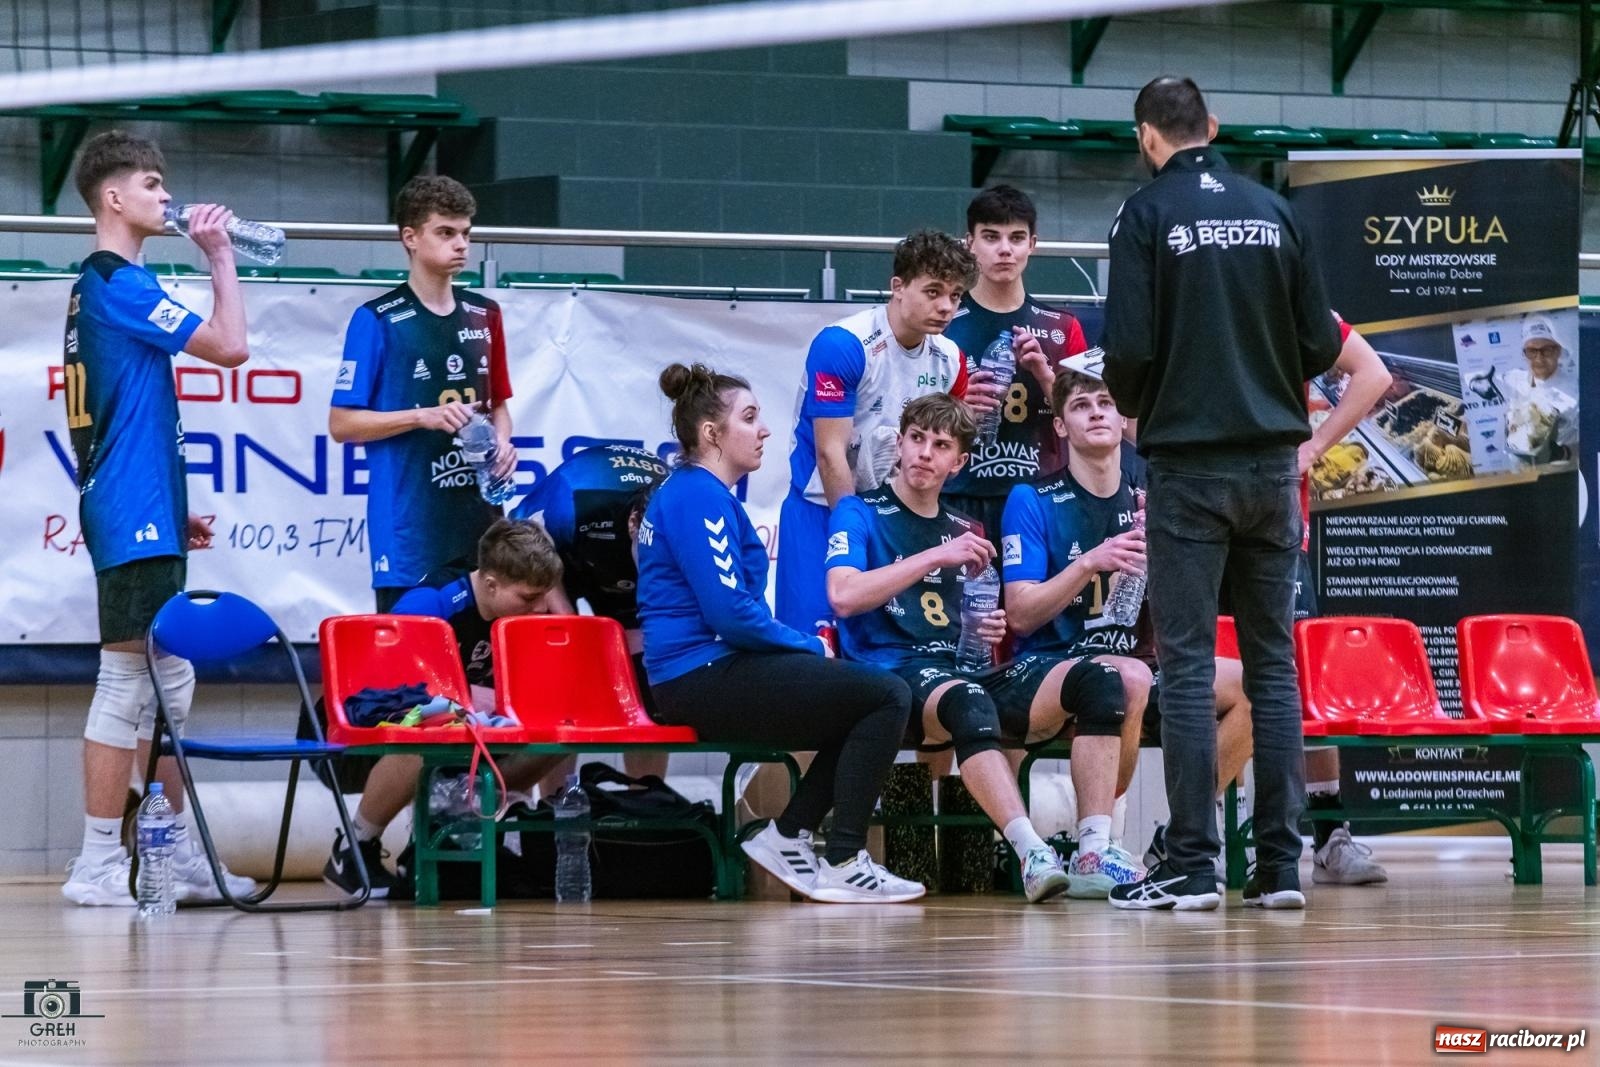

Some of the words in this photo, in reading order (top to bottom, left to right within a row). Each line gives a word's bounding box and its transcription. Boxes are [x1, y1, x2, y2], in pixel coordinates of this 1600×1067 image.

[1364, 215, 1509, 244] SZYPUŁA
[1198, 226, 1281, 250] BĘDZIN
[1375, 254, 1406, 266] LODY
[1409, 254, 1497, 266] MISTRZOWSKIE
[1389, 268, 1447, 280] Naturalnie
[1450, 268, 1483, 280] Dobre
[1416, 286, 1431, 296] Od
[1433, 286, 1457, 296] 1974
[458, 327, 485, 343] plus
[48, 366, 302, 406] DIO
[1004, 383, 1028, 423] 8
[970, 441, 1040, 466] NOWAK
[977, 463, 1037, 478] MOSTY
[1326, 516, 1398, 525] NIEPOWTARZALNE
[1399, 516, 1421, 525] LODY
[1423, 516, 1436, 525] DO
[1437, 516, 1468, 525] TWOJEJ
[1469, 516, 1508, 526] CUKIERNI,
[229, 522, 299, 557] 100,3
[309, 517, 367, 558] FM
[1326, 527, 1368, 536] KAWIARNI,
[1369, 527, 1422, 536] RESTAURACJI,
[1423, 527, 1455, 536] HOTELU
[1326, 546, 1379, 555] WIELOLETNIA
[1380, 546, 1420, 555] TRADYCJA
[1426, 545, 1493, 555] DOŚWIADCZENIE
[1326, 556, 1341, 566] JUŻ
[1343, 557, 1356, 566] OD
[1357, 557, 1376, 566] 1974
[1378, 557, 1400, 566] ROKU
[1326, 576, 1370, 586] STARANNIE
[1371, 576, 1459, 586] WYSELEKCJONOWANE,
[1326, 587, 1362, 596] LOKALNE
[1369, 587, 1415, 596] NATURALNE
[1417, 587, 1459, 596] SKŁADNIKI
[920, 591, 950, 627] 8
[1415, 747, 1464, 760] KONTAKT
[1383, 787, 1432, 799] Lodziarnia
[1434, 787, 1454, 801] pod
[1455, 787, 1505, 799] Orzechem
